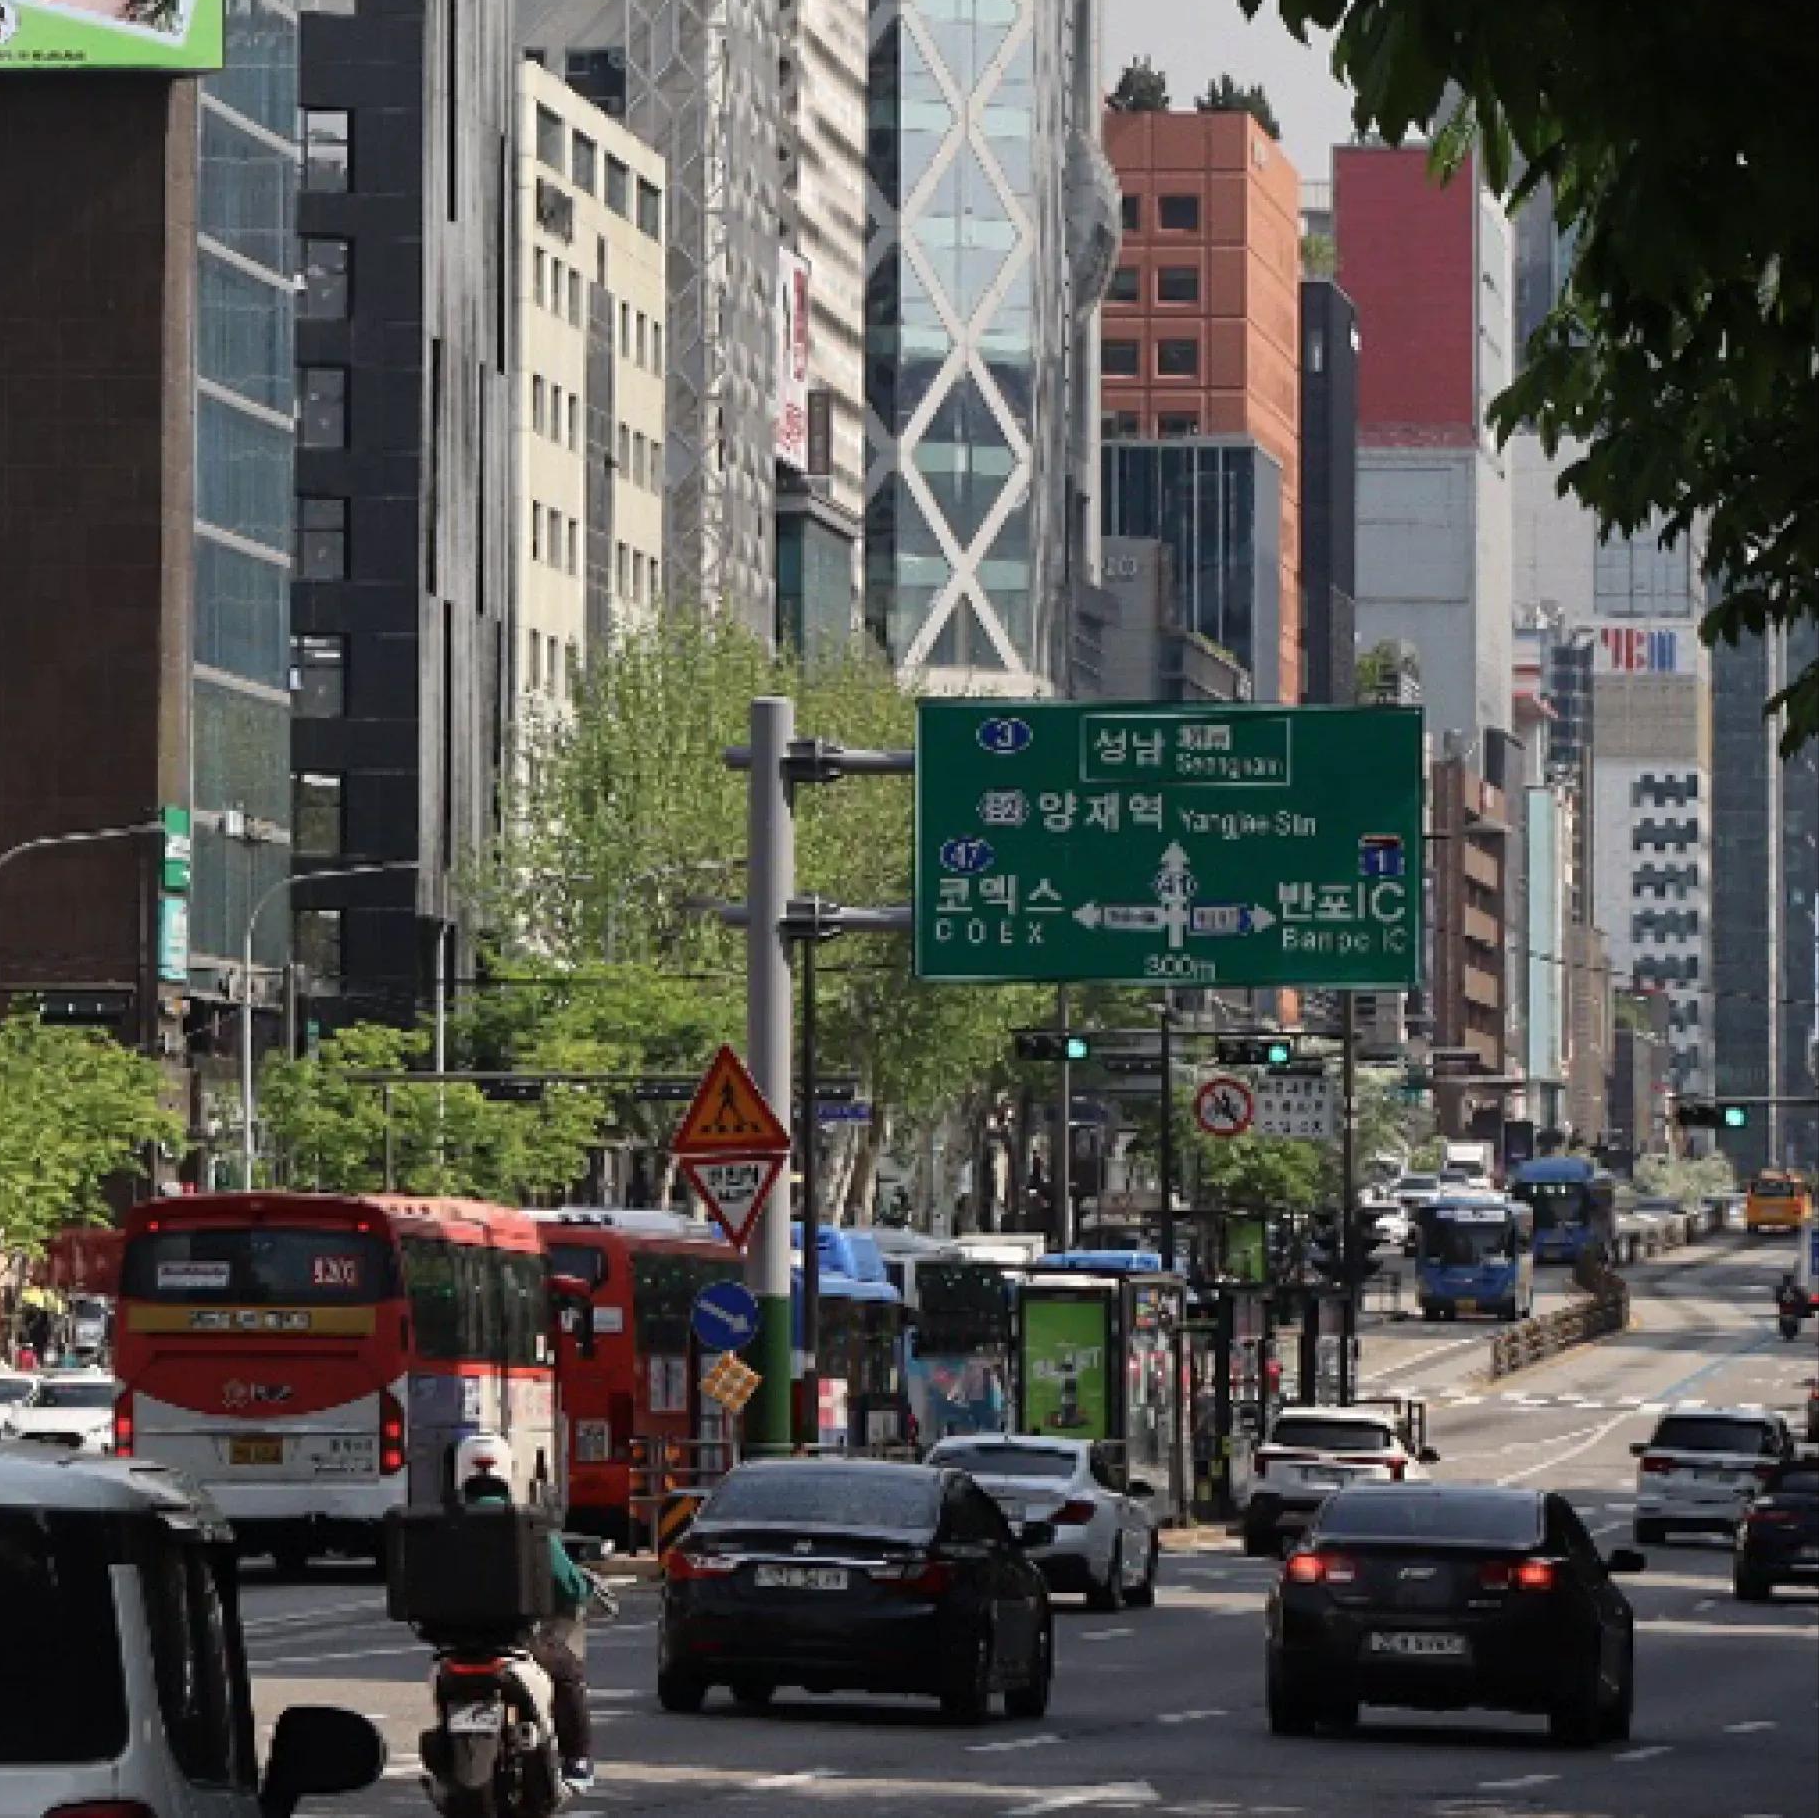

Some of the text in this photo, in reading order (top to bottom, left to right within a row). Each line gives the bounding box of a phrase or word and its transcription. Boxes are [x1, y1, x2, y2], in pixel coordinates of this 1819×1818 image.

[1095, 728, 1164, 767] 성남
[1038, 790, 1163, 834] 양재역
[935, 874, 1065, 916] 코엑스
[1278, 880, 1406, 925] 반포IC
[934, 917, 1045, 945] COEX
